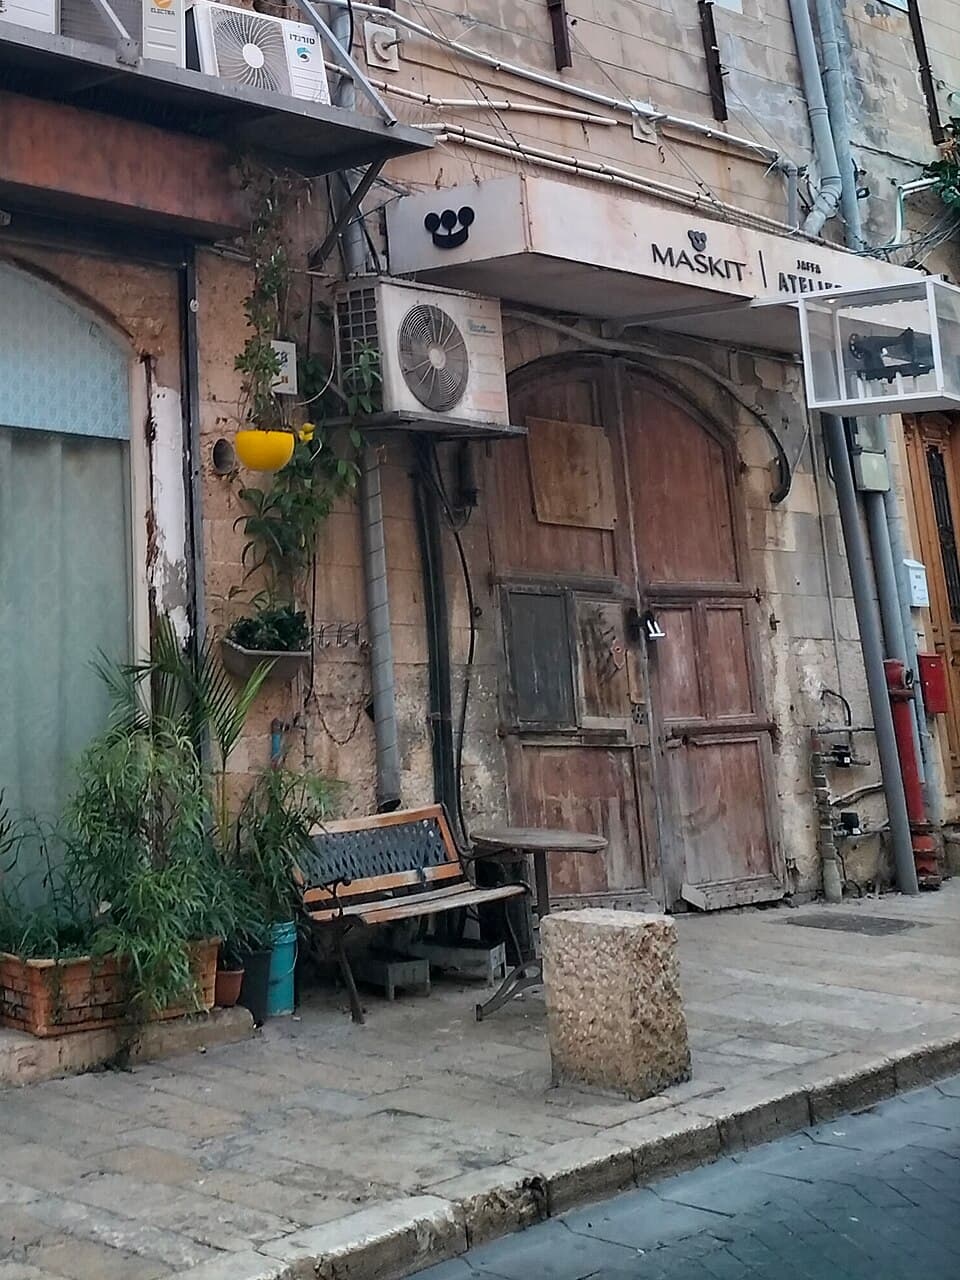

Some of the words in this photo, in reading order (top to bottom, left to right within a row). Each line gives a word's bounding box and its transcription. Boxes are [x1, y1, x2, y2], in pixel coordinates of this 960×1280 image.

[150, 7, 176, 16] ELECTRA
[289, 33, 316, 45] טורנדו
[651, 243, 747, 282] MASKIT
[796, 259, 822, 275] JAFFA
[778, 272, 843, 294] ATELI
